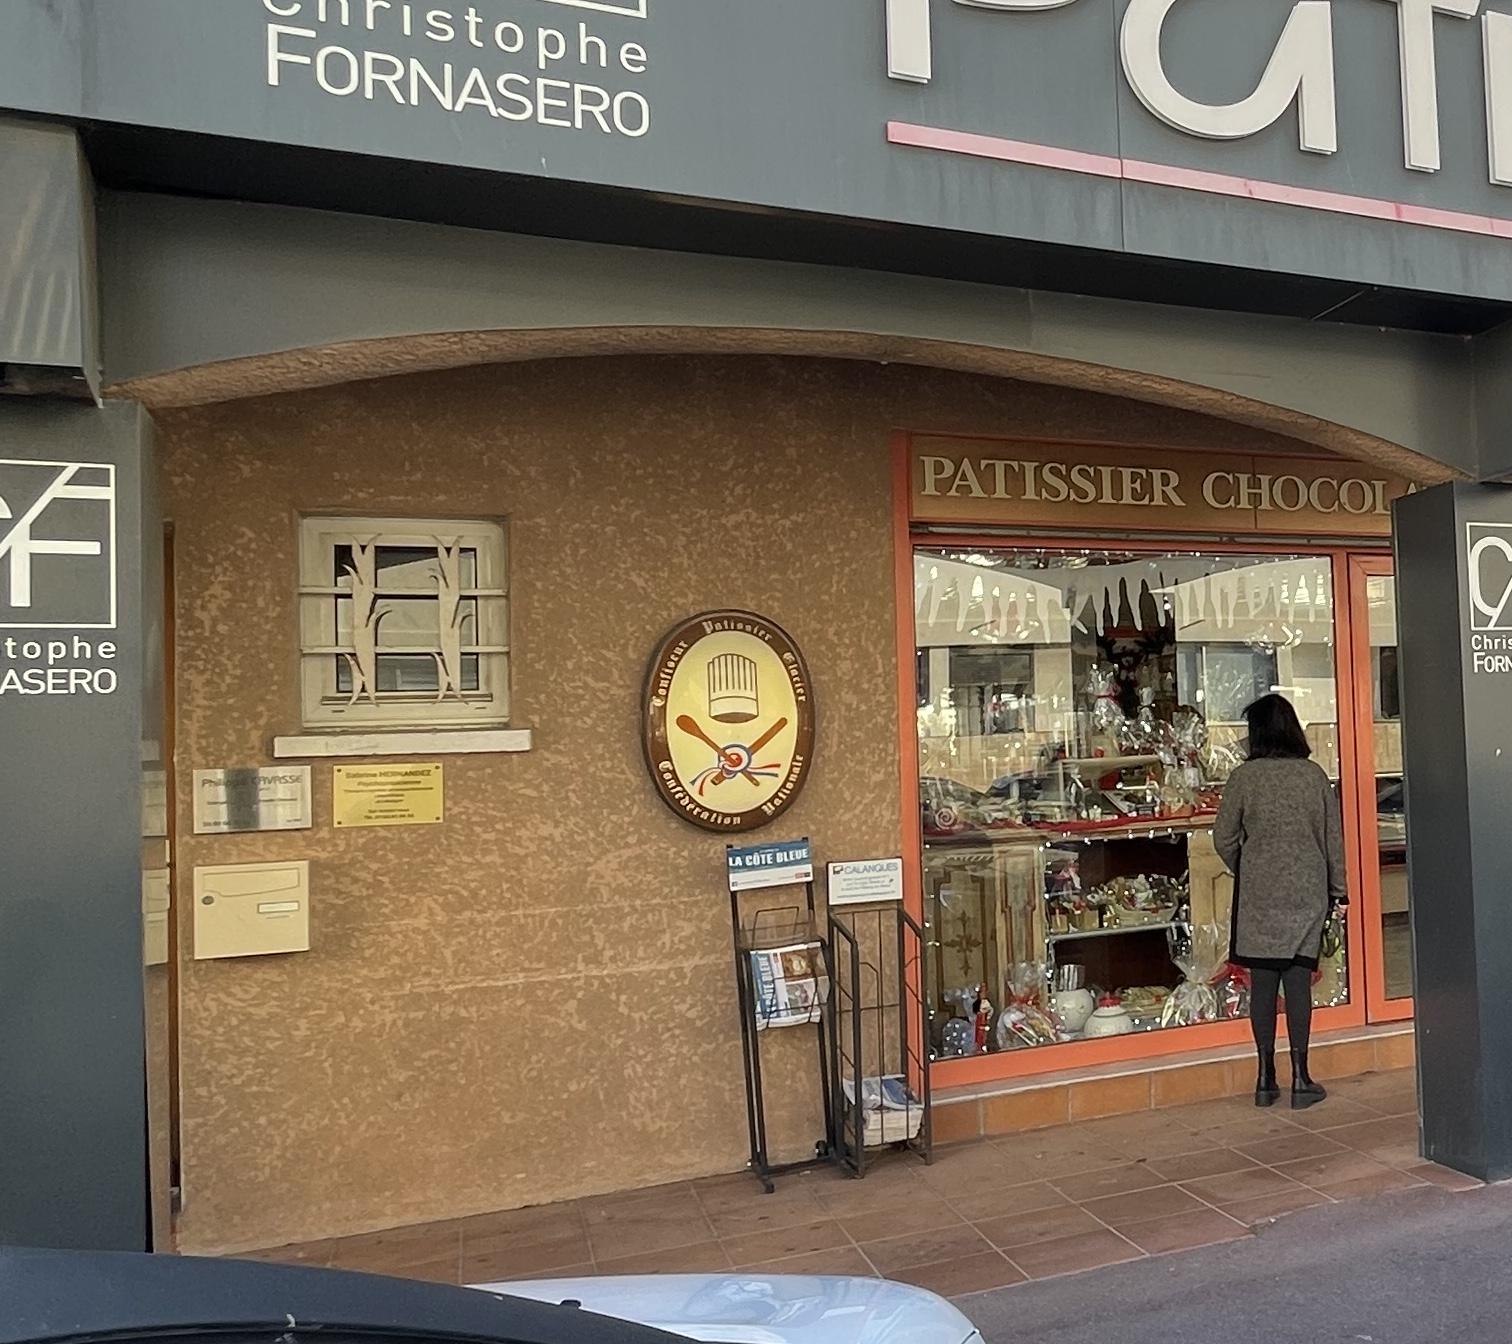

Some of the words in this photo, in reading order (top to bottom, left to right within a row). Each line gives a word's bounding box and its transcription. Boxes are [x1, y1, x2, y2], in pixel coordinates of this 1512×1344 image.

[267, 23, 650, 137] FORNASERO
[920, 455, 1187, 506] PATISSIER
[1202, 471, 1417, 516] CHOCOL
[4, 635, 117, 666] tophe
[0, 668, 117, 695] ASERO
[728, 855, 743, 867] LA
[745, 851, 774, 866] CÔTE
[776, 848, 809, 863] BLEUE
[844, 862, 899, 875] CALANQUES
